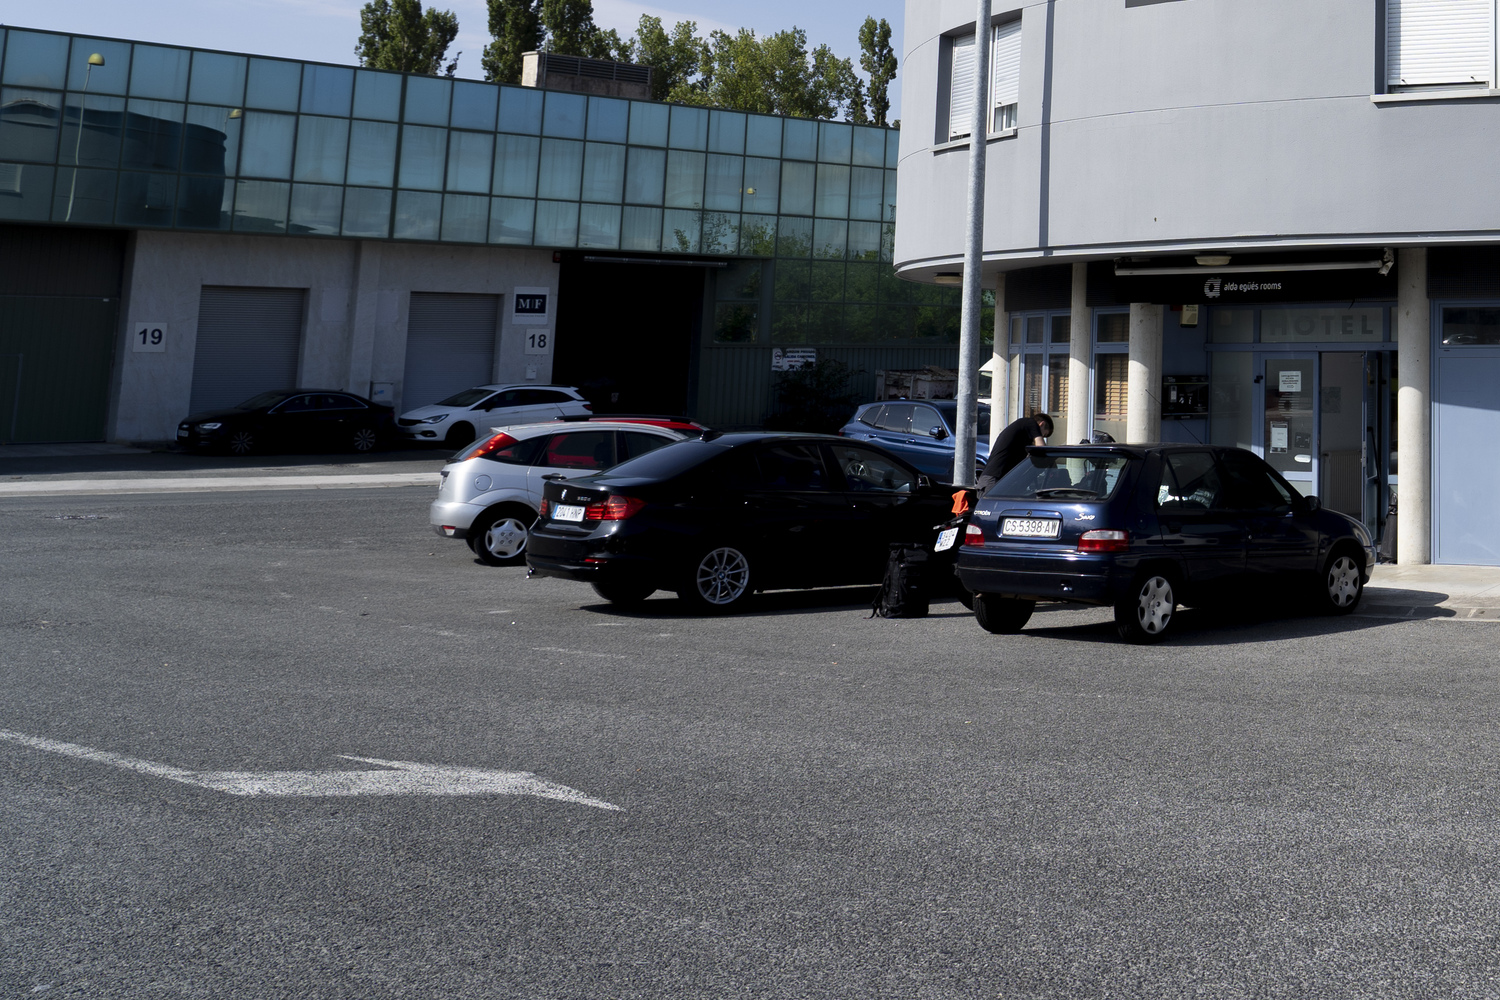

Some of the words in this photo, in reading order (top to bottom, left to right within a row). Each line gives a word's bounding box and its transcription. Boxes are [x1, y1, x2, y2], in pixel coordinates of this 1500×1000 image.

[1223, 282, 1238, 291] alda
[1239, 281, 1259, 293] egüés
[1260, 282, 1282, 290] rooms
[1269, 314, 1374, 336] HOTEL
[139, 328, 163, 345] 19
[528, 333, 547, 348] 18
